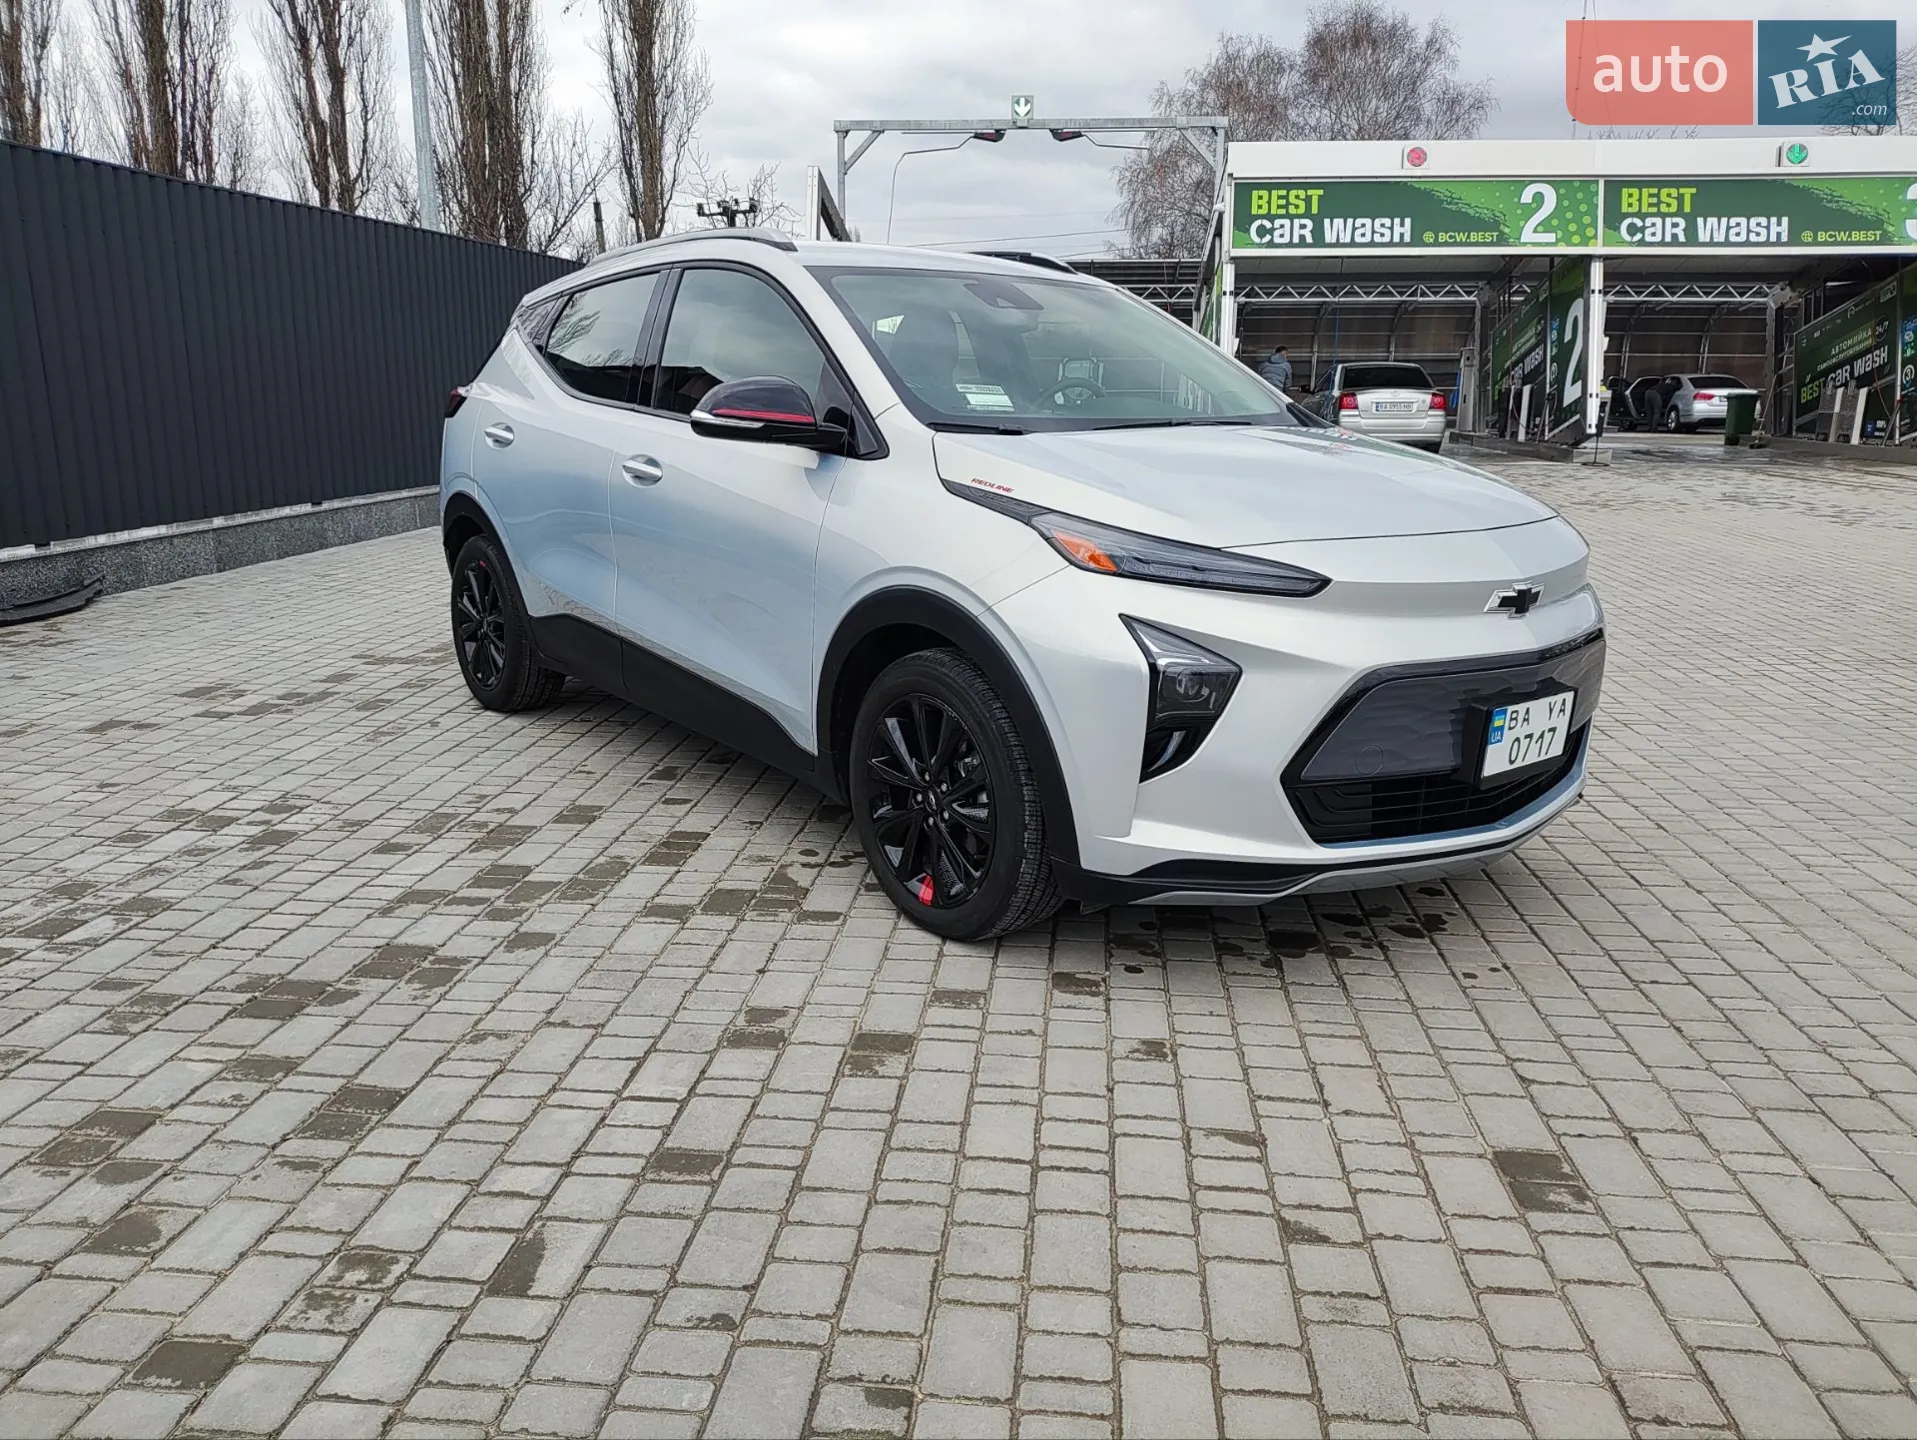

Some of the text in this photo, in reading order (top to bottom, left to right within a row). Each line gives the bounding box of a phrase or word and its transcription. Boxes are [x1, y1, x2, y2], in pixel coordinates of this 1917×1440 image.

[1251, 189, 1324, 215] BEST
[1520, 183, 1557, 243] 2
[1621, 187, 1697, 213] BEST
[1438, 231, 1499, 243] BCW.BEST
[1817, 230, 1883, 242] BCW.BEST
[1563, 298, 1584, 408] 2
[971, 478, 1015, 493] REDLINE
[1508, 698, 1566, 731] BA YA
[1491, 731, 1501, 743] UA
[1508, 726, 1558, 765] 0717
